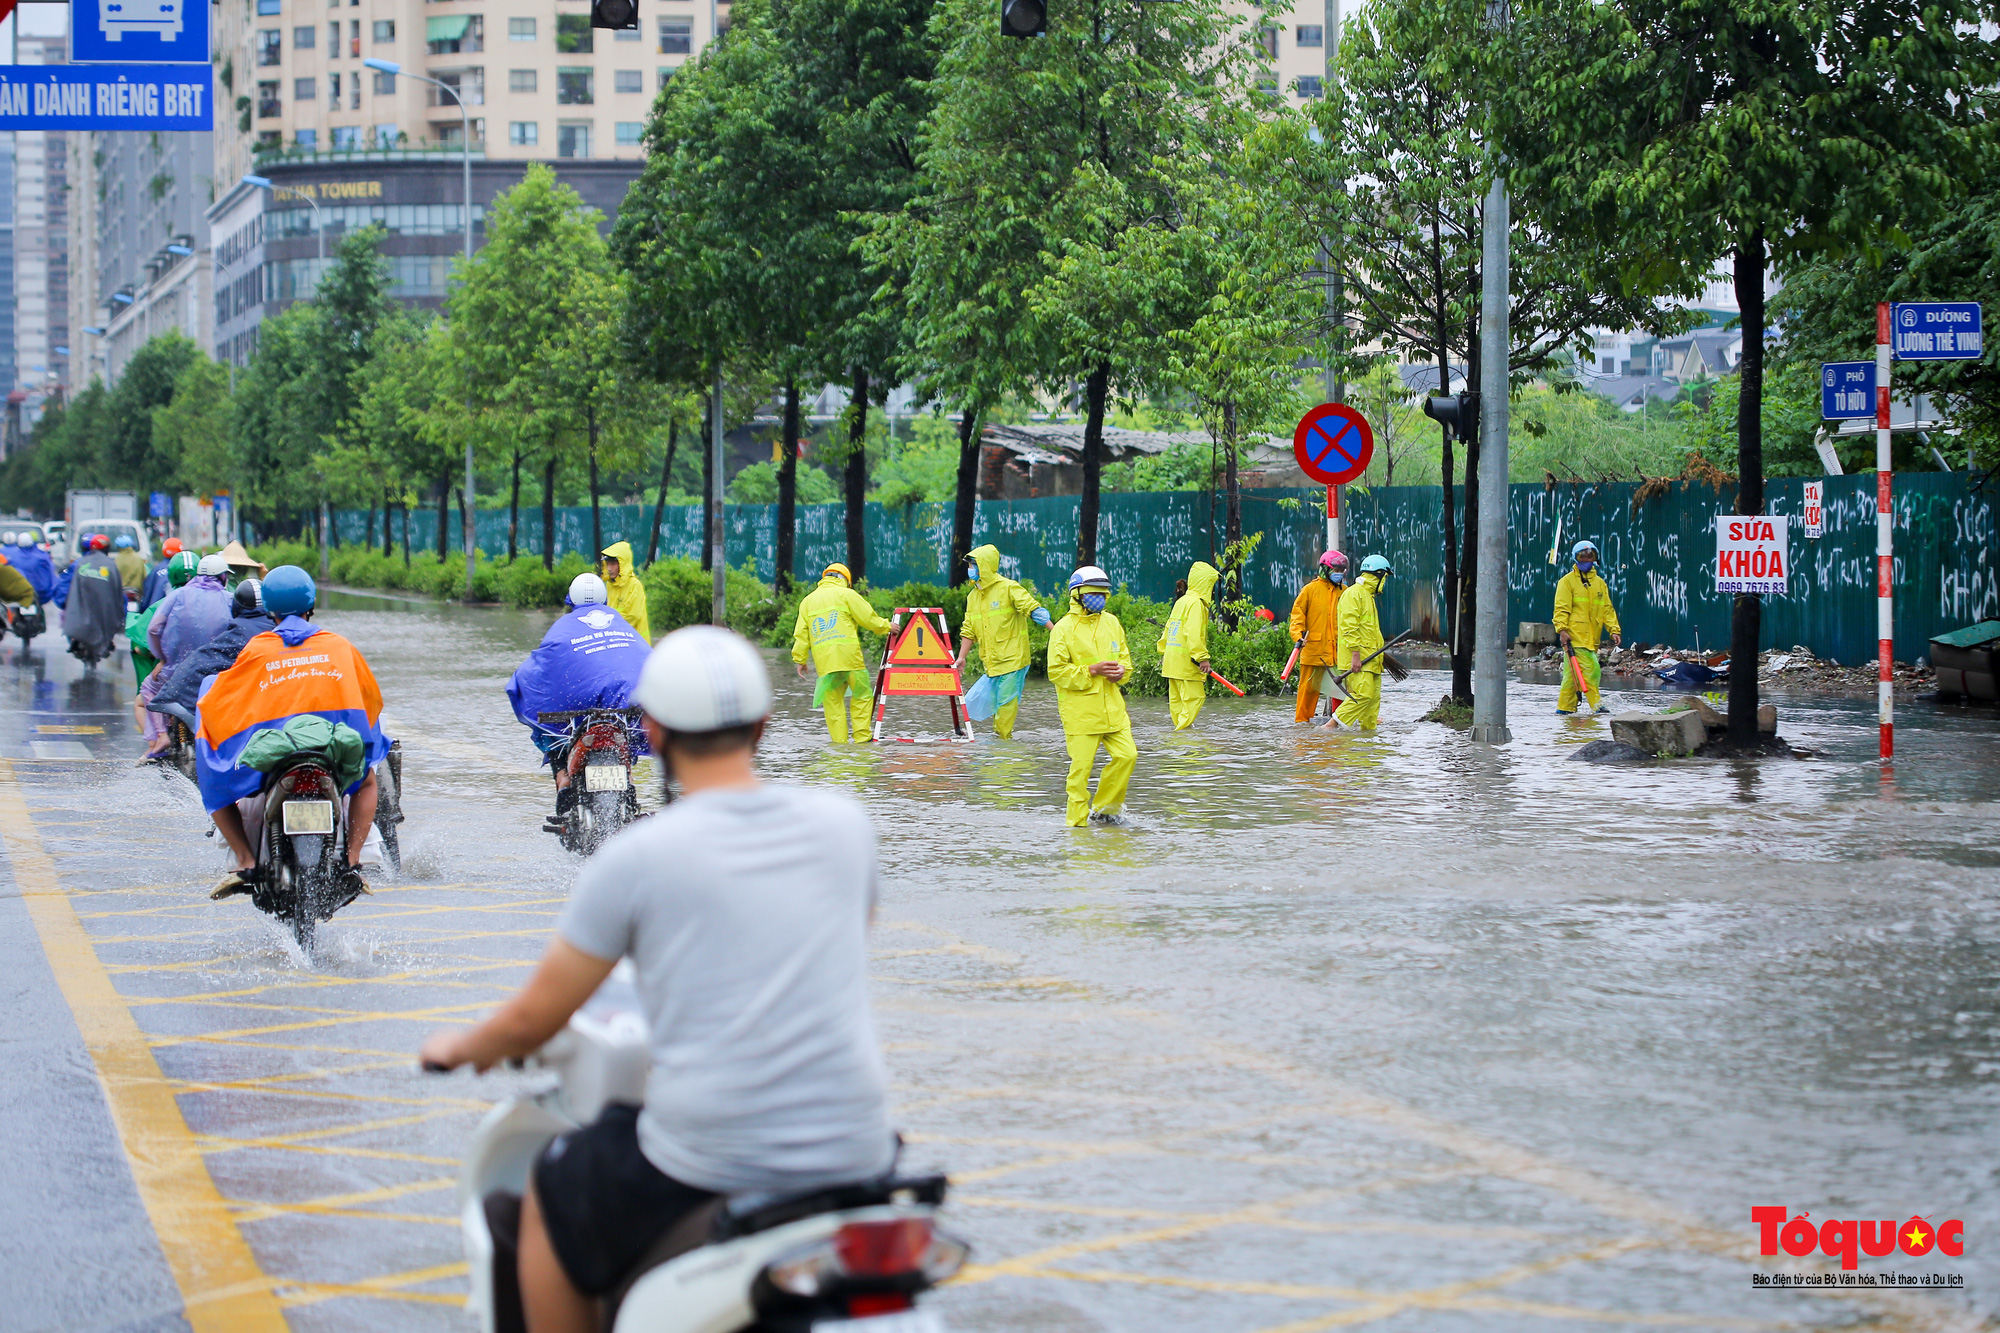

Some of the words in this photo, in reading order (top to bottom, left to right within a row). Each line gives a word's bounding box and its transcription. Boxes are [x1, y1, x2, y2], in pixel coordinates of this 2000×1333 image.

[34, 75, 91, 116] DÀNH
[96, 75, 159, 117] RIÊNG
[164, 83, 204, 117] BRT
[319, 181, 382, 199] TOWER
[1925, 308, 1971, 323] ĐƯỜNG
[1935, 325, 1955, 351] THẾ
[1956, 332, 1980, 351] VINH
[1845, 366, 1865, 382] PHỐ
[1834, 385, 1846, 412] TỐ
[1728, 515, 1775, 541] SỬA
[1719, 545, 1784, 578] KHÓA
[1718, 582, 1742, 593] 0969
[1745, 582, 1769, 593] 7676
[1772, 582, 1785, 593] 83
[570, 634, 593, 645] Honda
[265, 660, 281, 671] GAS
[281, 654, 330, 668] PETROLIMEX
[287, 668, 309, 679] chọn
[310, 667, 325, 676] tin
